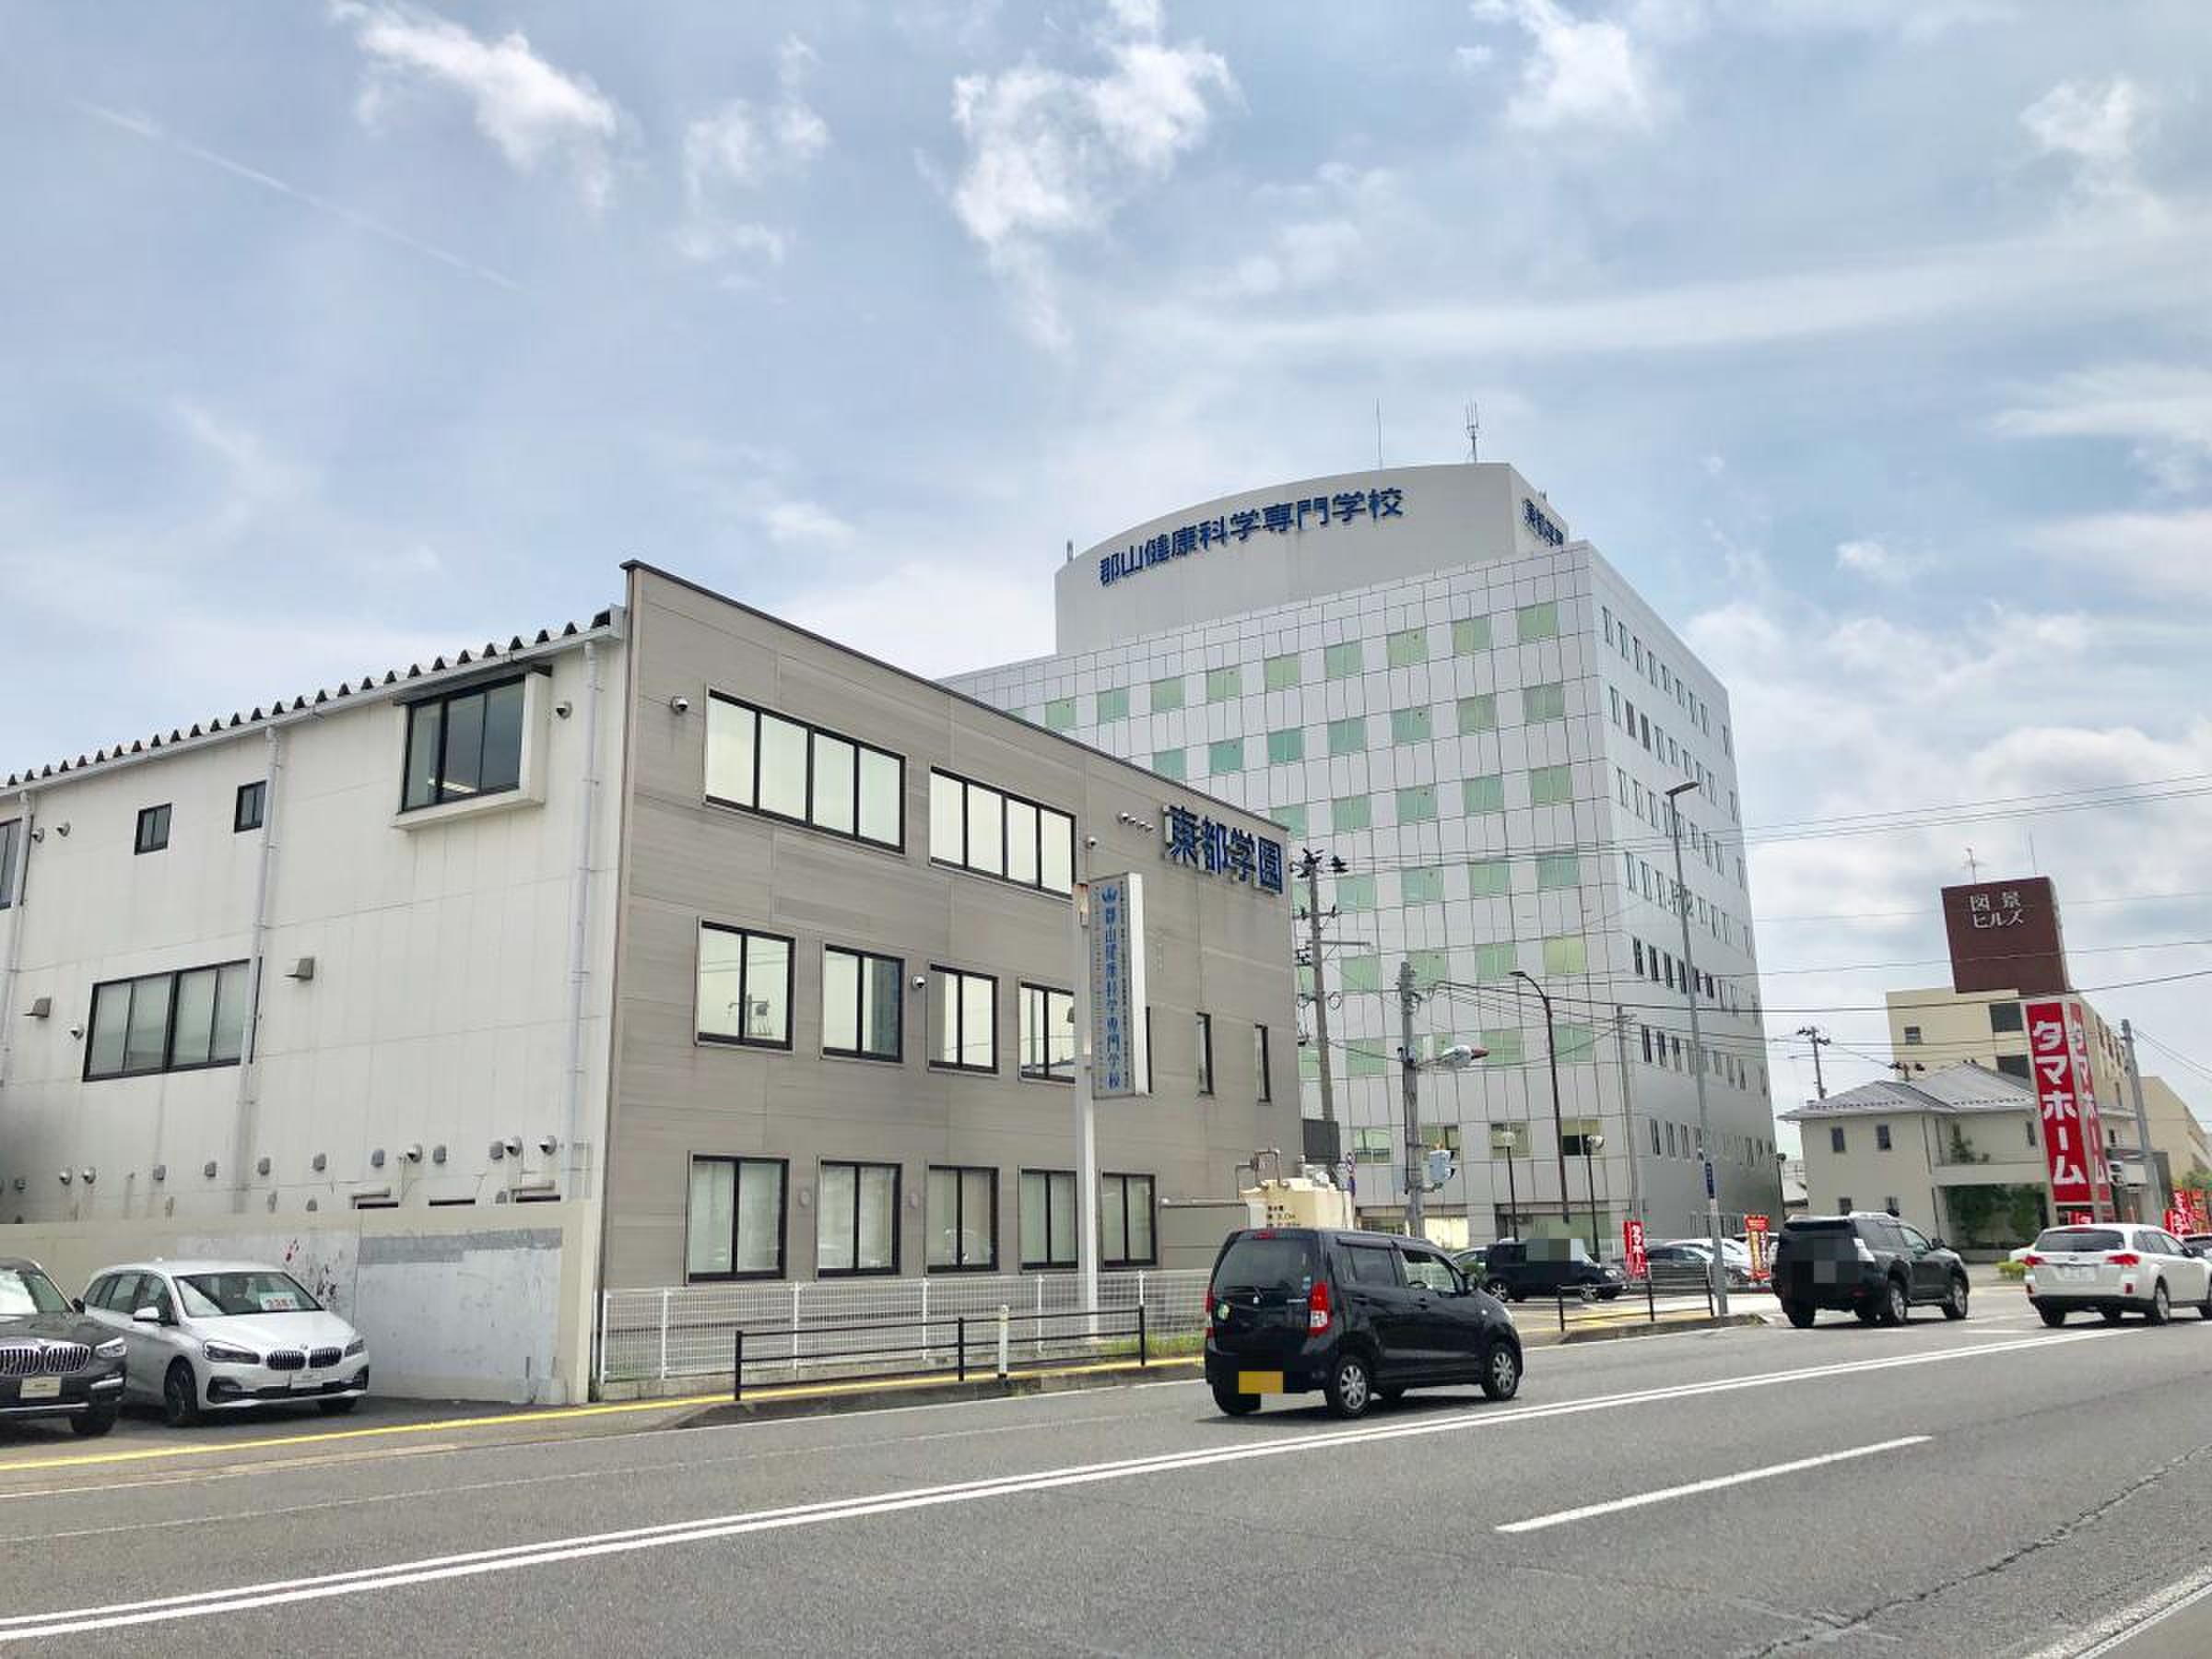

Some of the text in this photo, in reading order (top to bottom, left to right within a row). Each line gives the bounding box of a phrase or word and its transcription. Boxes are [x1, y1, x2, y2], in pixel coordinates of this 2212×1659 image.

[1100, 488, 1404, 586] 郡山健康科学専門学校
[1165, 805, 1283, 895] 東都学園
[2031, 1020, 2087, 1185] タマホーム
